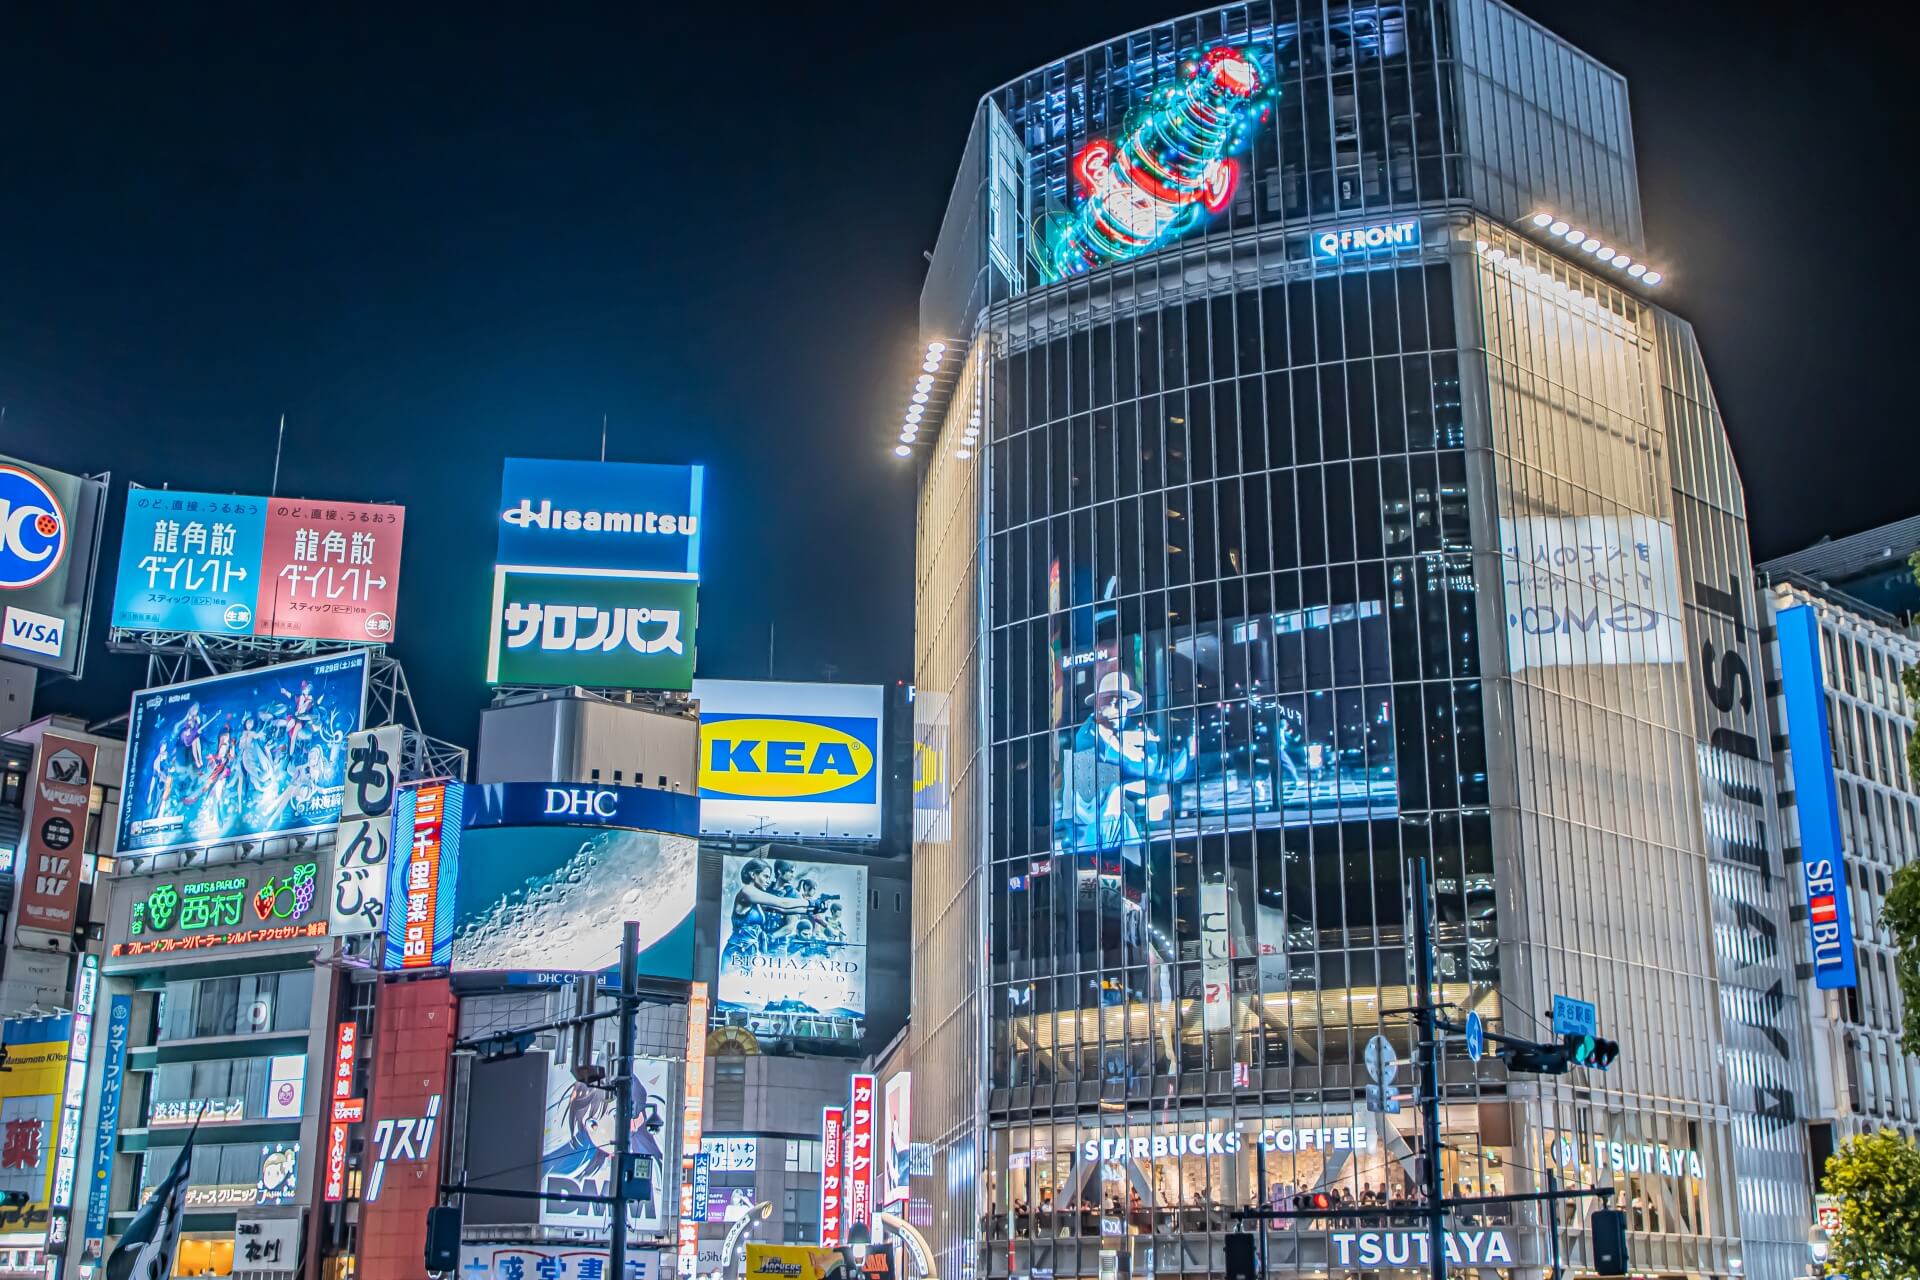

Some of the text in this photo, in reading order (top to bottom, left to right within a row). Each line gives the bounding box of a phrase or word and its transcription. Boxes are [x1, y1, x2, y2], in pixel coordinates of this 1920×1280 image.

[277, 507, 396, 524] のど、直接、うるおう
[153, 519, 237, 556] 龍角散
[294, 528, 376, 565] 龍角散
[138, 556, 247, 593] ダイレクト
[280, 564, 387, 601] ダイレクト
[289, 602, 331, 612] スティック
[11, 617, 60, 647] VISA
[505, 603, 683, 655] サロンパス
[711, 739, 859, 775] KEA
[544, 788, 618, 818] DHC
[335, 733, 394, 928] もんじゃ
[1694, 573, 1796, 1137] TSUTAYA
[35, 876, 70, 896] B2F
[403, 793, 438, 957] 三千里薬品
[131, 902, 145, 935] 渋谷
[180, 892, 245, 930] 西村
[1805, 859, 1842, 968] SEIBU
[538, 973, 606, 985] DHC Chel
[731, 955, 858, 973] BIOHAZARD
[98, 1024, 125, 1165] サマーフルーツギフト
[2, 1117, 45, 1170] 薬
[853, 1087, 871, 1170] カラオケ
[1084, 1126, 1367, 1161] STARBUCKS COFFEE
[711, 1157, 754, 1168] リニック
[714, 1142, 755, 1153] れいわ
[1594, 1140, 1706, 1179] TSUTAYA
[185, 1188, 258, 1205] ディースクリニック
[545, 1177, 657, 1219] DMM
[1332, 1231, 1512, 1265] TSUTAYA
